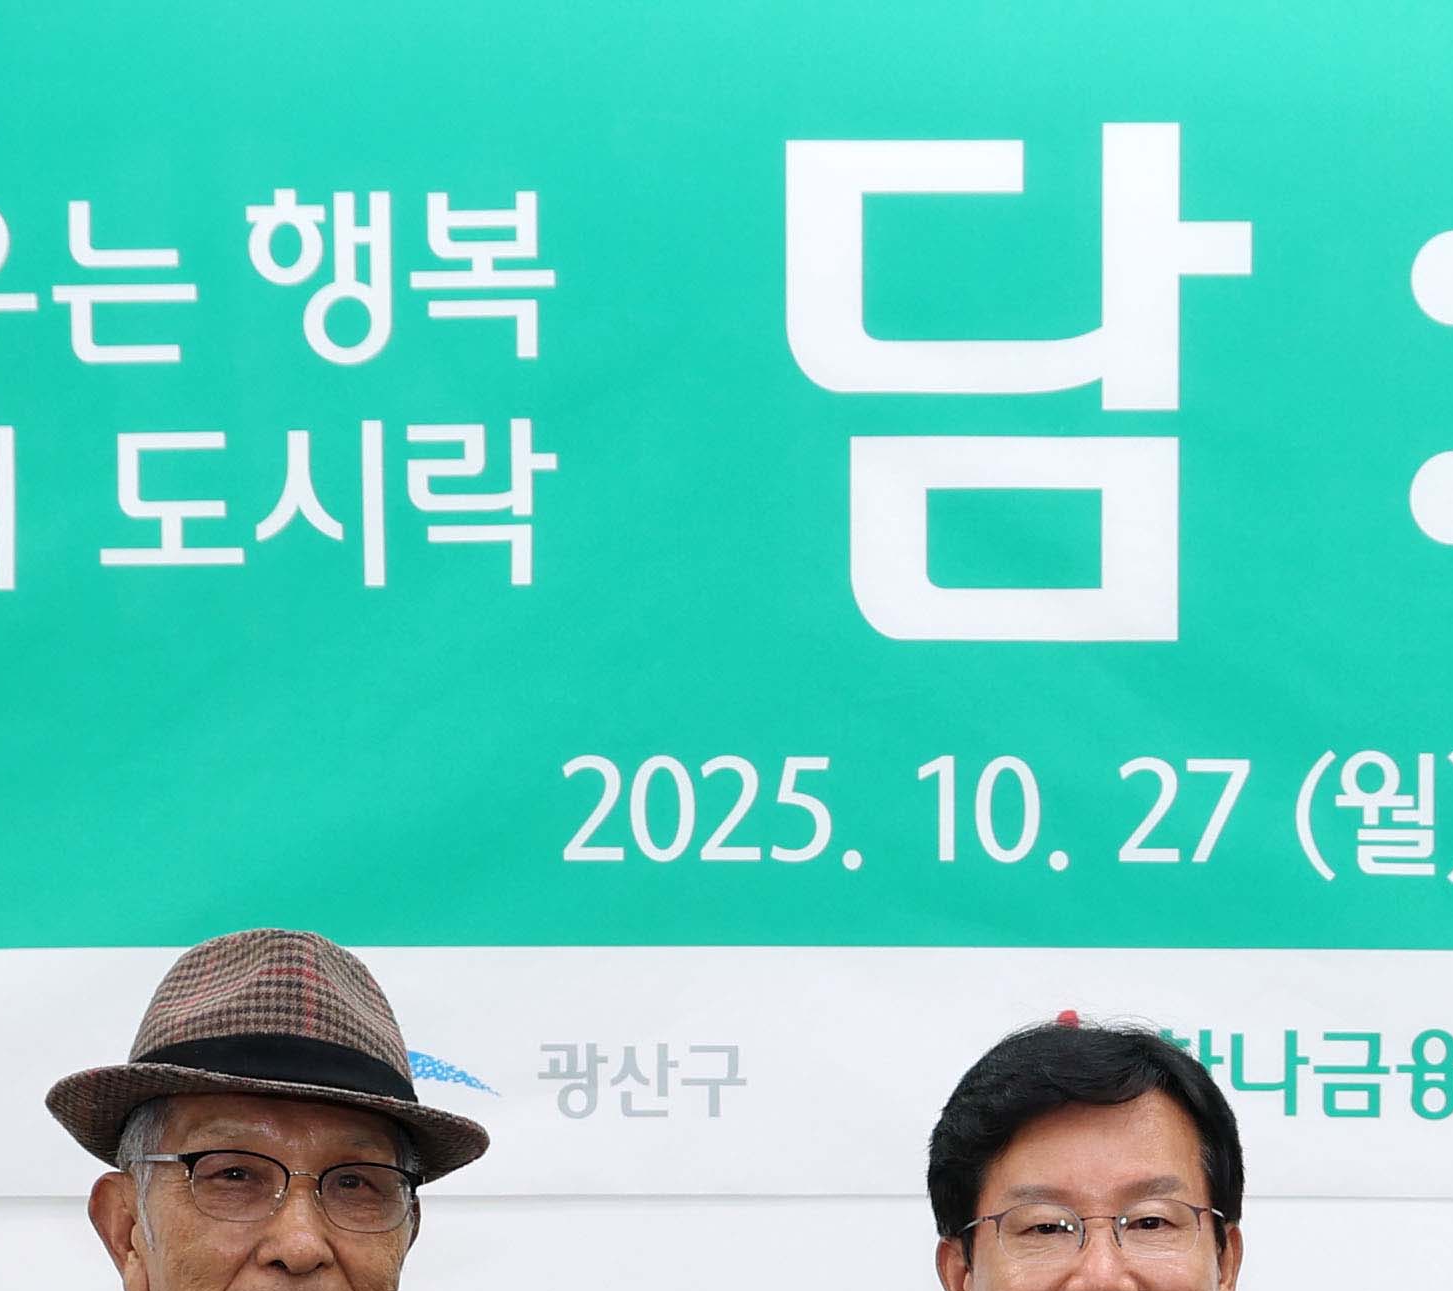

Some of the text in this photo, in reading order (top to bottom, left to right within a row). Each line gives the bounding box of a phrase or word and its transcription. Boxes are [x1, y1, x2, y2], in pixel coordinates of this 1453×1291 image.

[246, 189, 556, 365] 행복
[100, 419, 558, 587] 도시락
[563, 755, 862, 870] 2025.
[918, 756, 1069, 871] 10.
[1119, 757, 1251, 862] 27
[538, 1044, 746, 1118] 광산구
